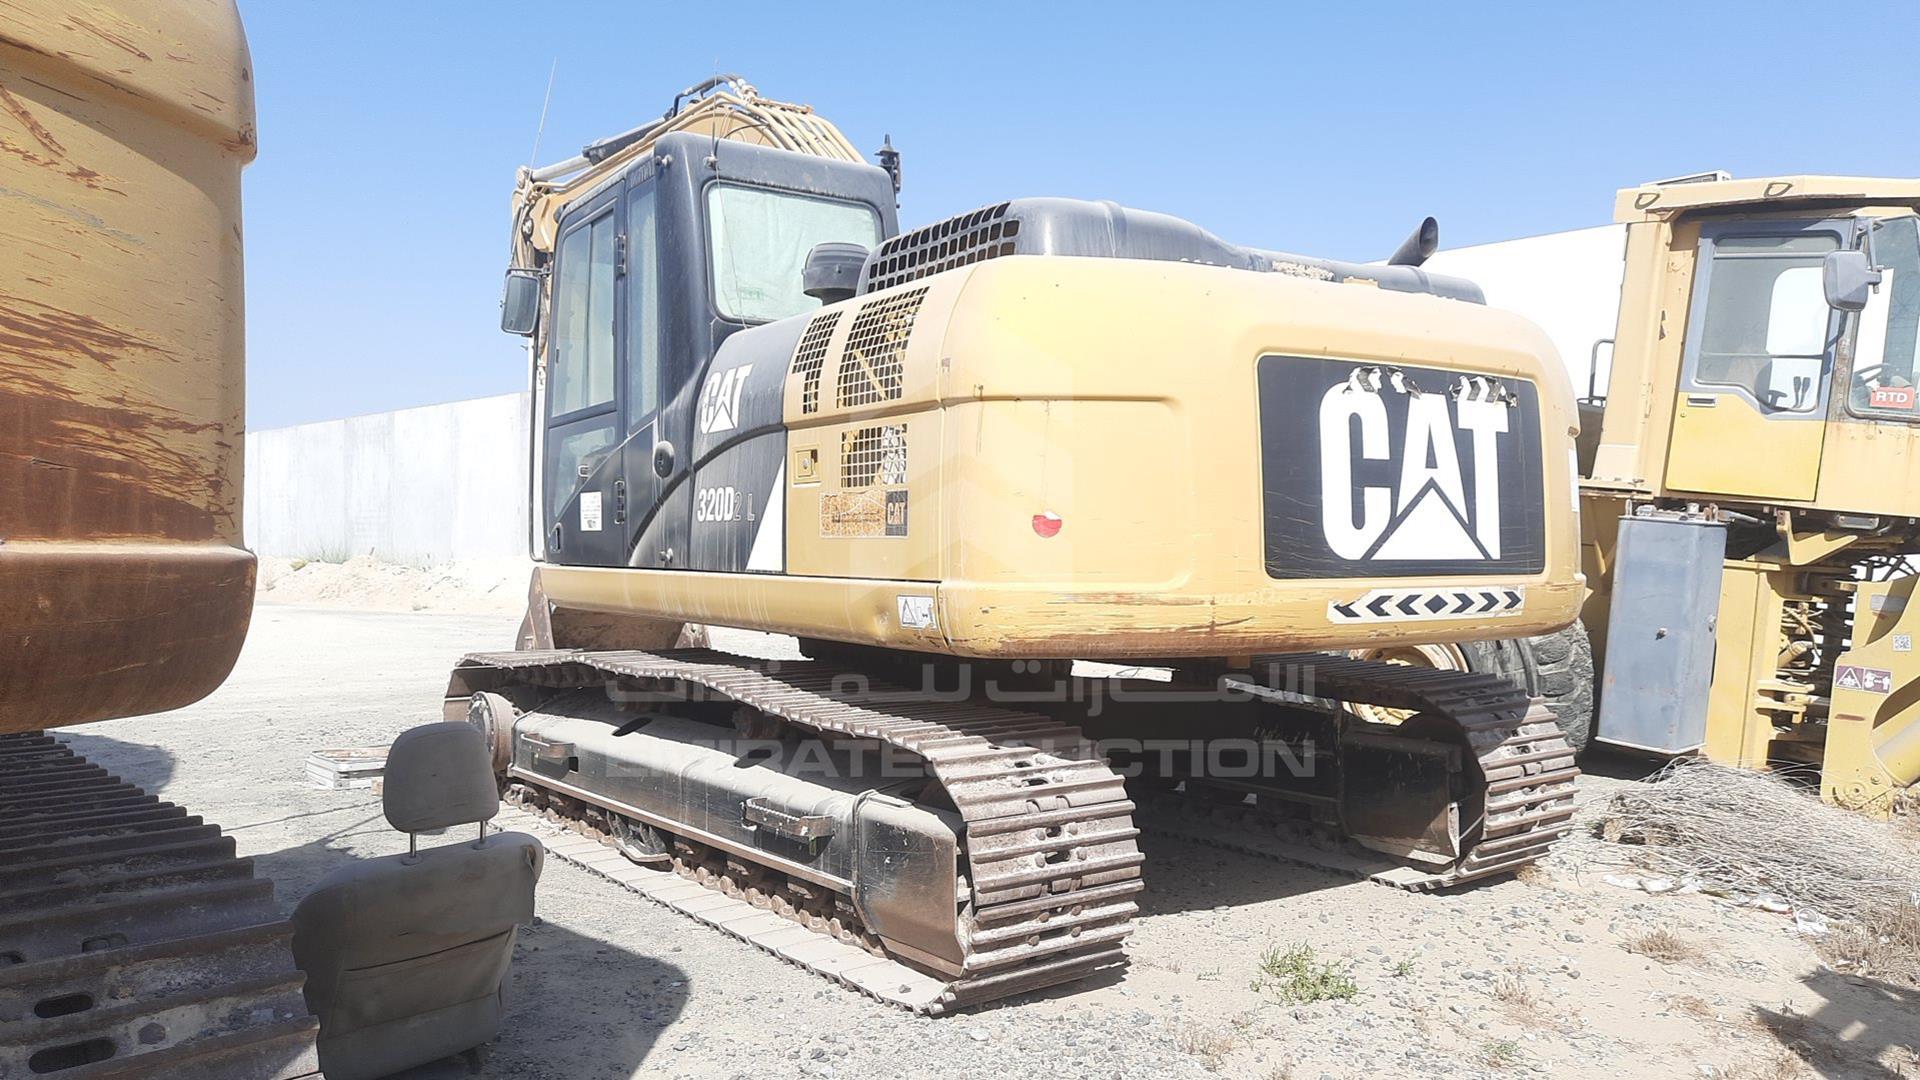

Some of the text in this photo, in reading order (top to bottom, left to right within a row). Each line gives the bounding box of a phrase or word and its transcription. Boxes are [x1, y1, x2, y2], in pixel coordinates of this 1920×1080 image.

[701, 364, 754, 434] CAT
[1875, 390, 1908, 403] RTD
[1318, 376, 1510, 561] CAT
[887, 502, 906, 525] CAT
